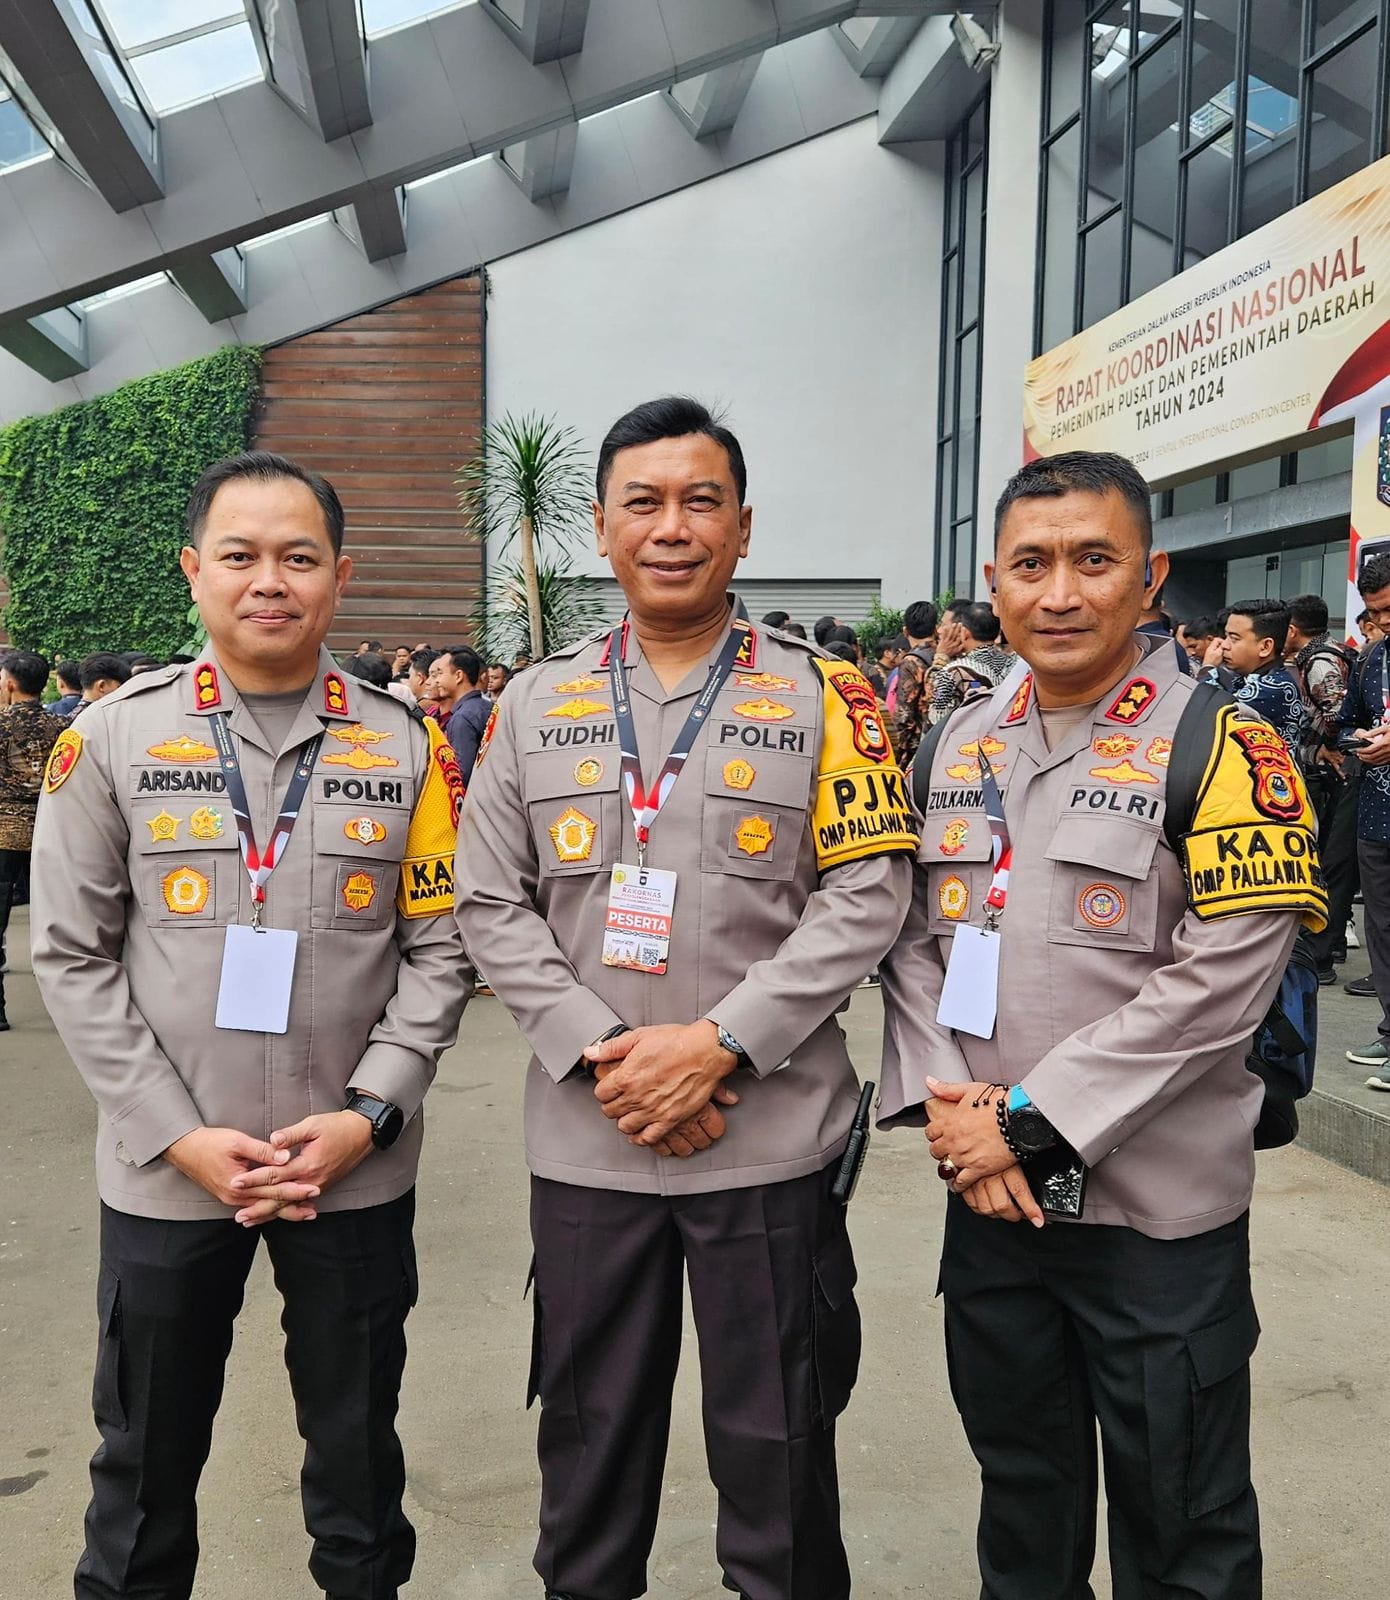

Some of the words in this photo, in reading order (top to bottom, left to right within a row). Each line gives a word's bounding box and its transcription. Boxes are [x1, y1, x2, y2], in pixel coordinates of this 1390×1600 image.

[1108, 325, 1146, 353] KEMENTERIAN
[1147, 314, 1169, 332] DALAM
[1169, 301, 1193, 321] NEGERI
[1193, 283, 1228, 308] REPUBLIK
[1228, 259, 1271, 289] INDONESIA
[1056, 369, 1103, 416] RAPAT
[1107, 307, 1222, 391] KOORDINASI
[1231, 235, 1365, 333] NASIONAL
[1051, 398, 1114, 441] PEMERINTAH
[1118, 379, 1154, 412] PUSAT
[1158, 365, 1185, 394] DAN
[1191, 318, 1290, 380] PEMERINTAH
[1297, 280, 1374, 334] DAERAH
[1136, 393, 1182, 431] TAHUN
[1188, 377, 1224, 411] 2024
[1230, 404, 1279, 431] CONVENTION
[1280, 393, 1312, 413] CENTER
[539, 724, 615, 747] YUDHI
[720, 723, 805, 753] POLRI
[137, 769, 227, 793] ARISAND
[323, 778, 402, 804] POLRI
[1070, 788, 1159, 820] POLRI
[819, 821, 846, 850] OMP
[847, 812, 904, 842] PALLAWA
[1216, 829, 1274, 863] KA
[1194, 865, 1225, 895] OMP
[1230, 859, 1307, 890] PALLAWA
[608, 911, 668, 932] PESERTA
